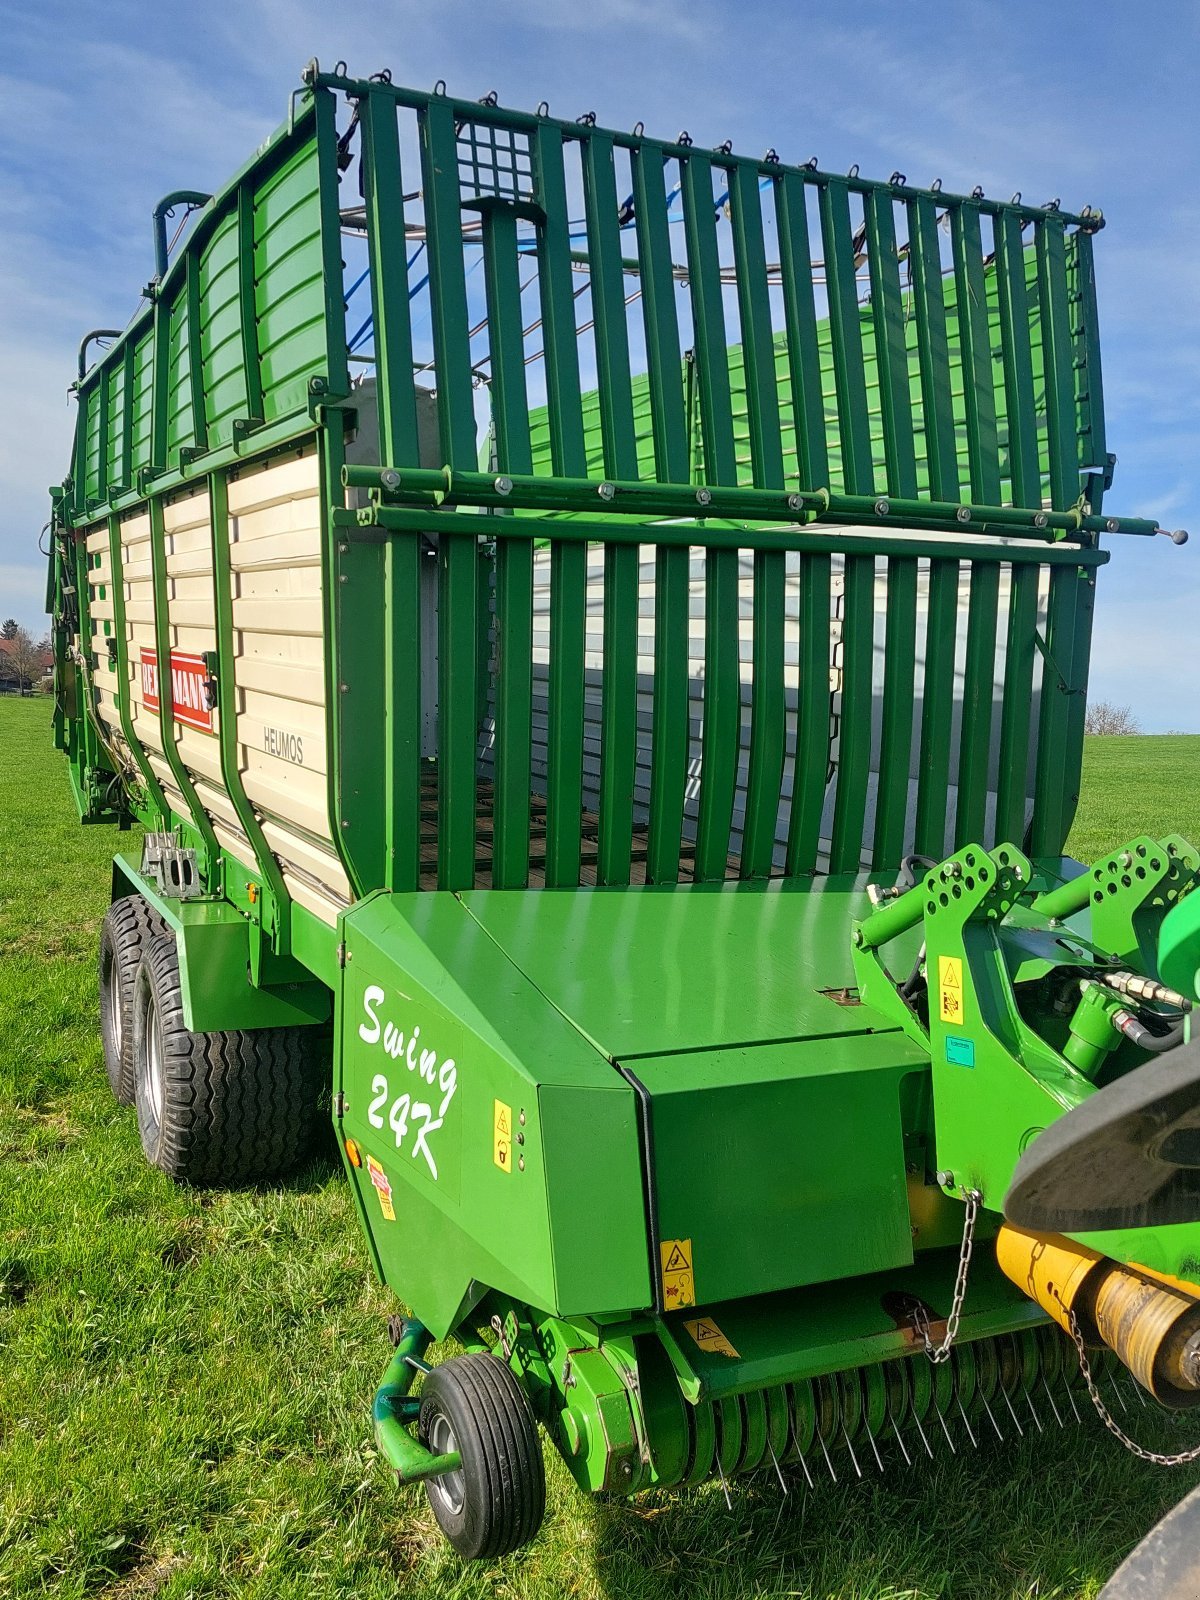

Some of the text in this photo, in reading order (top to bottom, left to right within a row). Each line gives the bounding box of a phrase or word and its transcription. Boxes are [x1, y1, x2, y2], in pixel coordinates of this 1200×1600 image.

[263, 726, 303, 764] HEUMOS
[358, 985, 457, 1118] Swing
[367, 1073, 443, 1181] 24K
